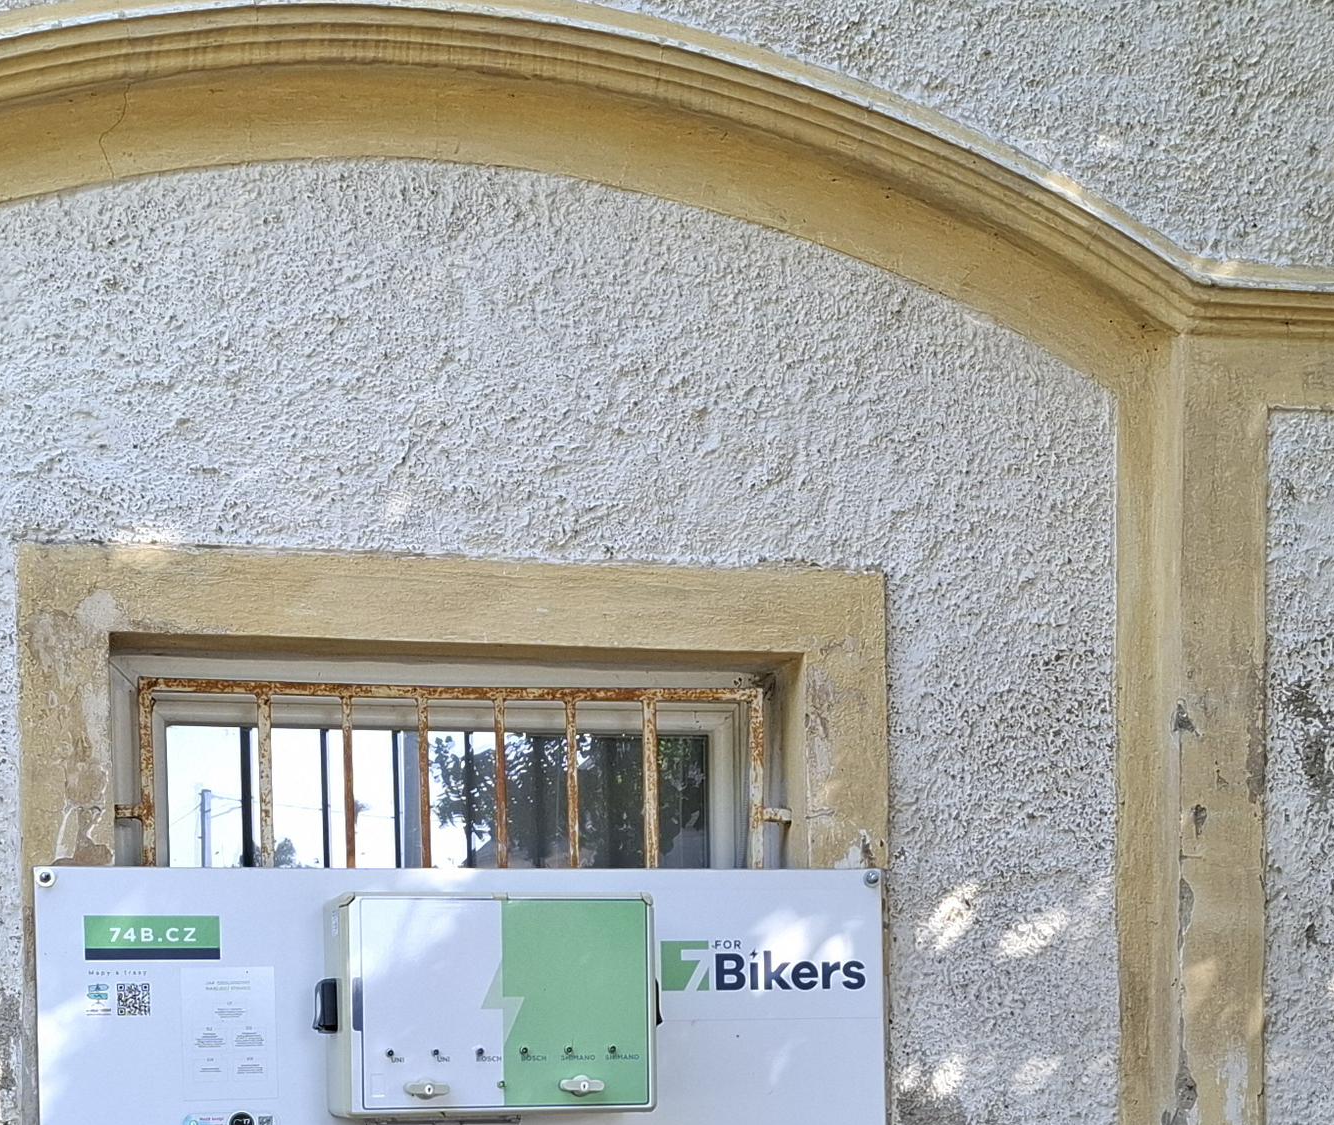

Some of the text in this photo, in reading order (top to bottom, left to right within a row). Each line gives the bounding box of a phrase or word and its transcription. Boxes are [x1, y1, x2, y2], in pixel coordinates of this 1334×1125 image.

[109, 927, 197, 943] 74B.CZ
[714, 940, 742, 949] FOR
[715, 950, 866, 991] Bikers
